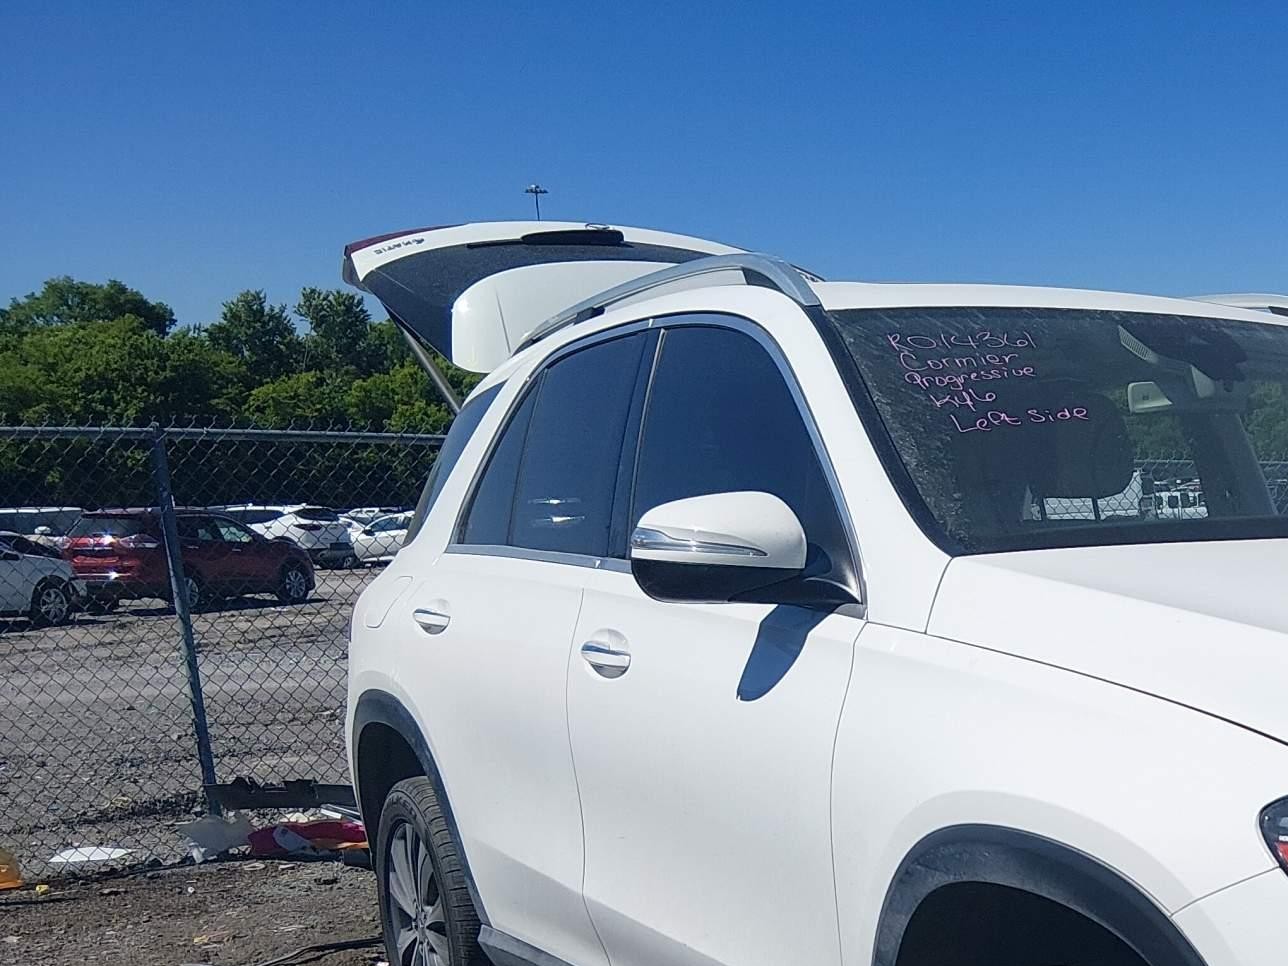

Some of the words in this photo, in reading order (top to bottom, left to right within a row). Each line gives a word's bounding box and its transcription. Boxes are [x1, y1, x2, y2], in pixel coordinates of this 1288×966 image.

[900, 351, 1019, 371] Cormier
[904, 366, 1036, 390] Progressive
[951, 411, 1021, 433] Left
